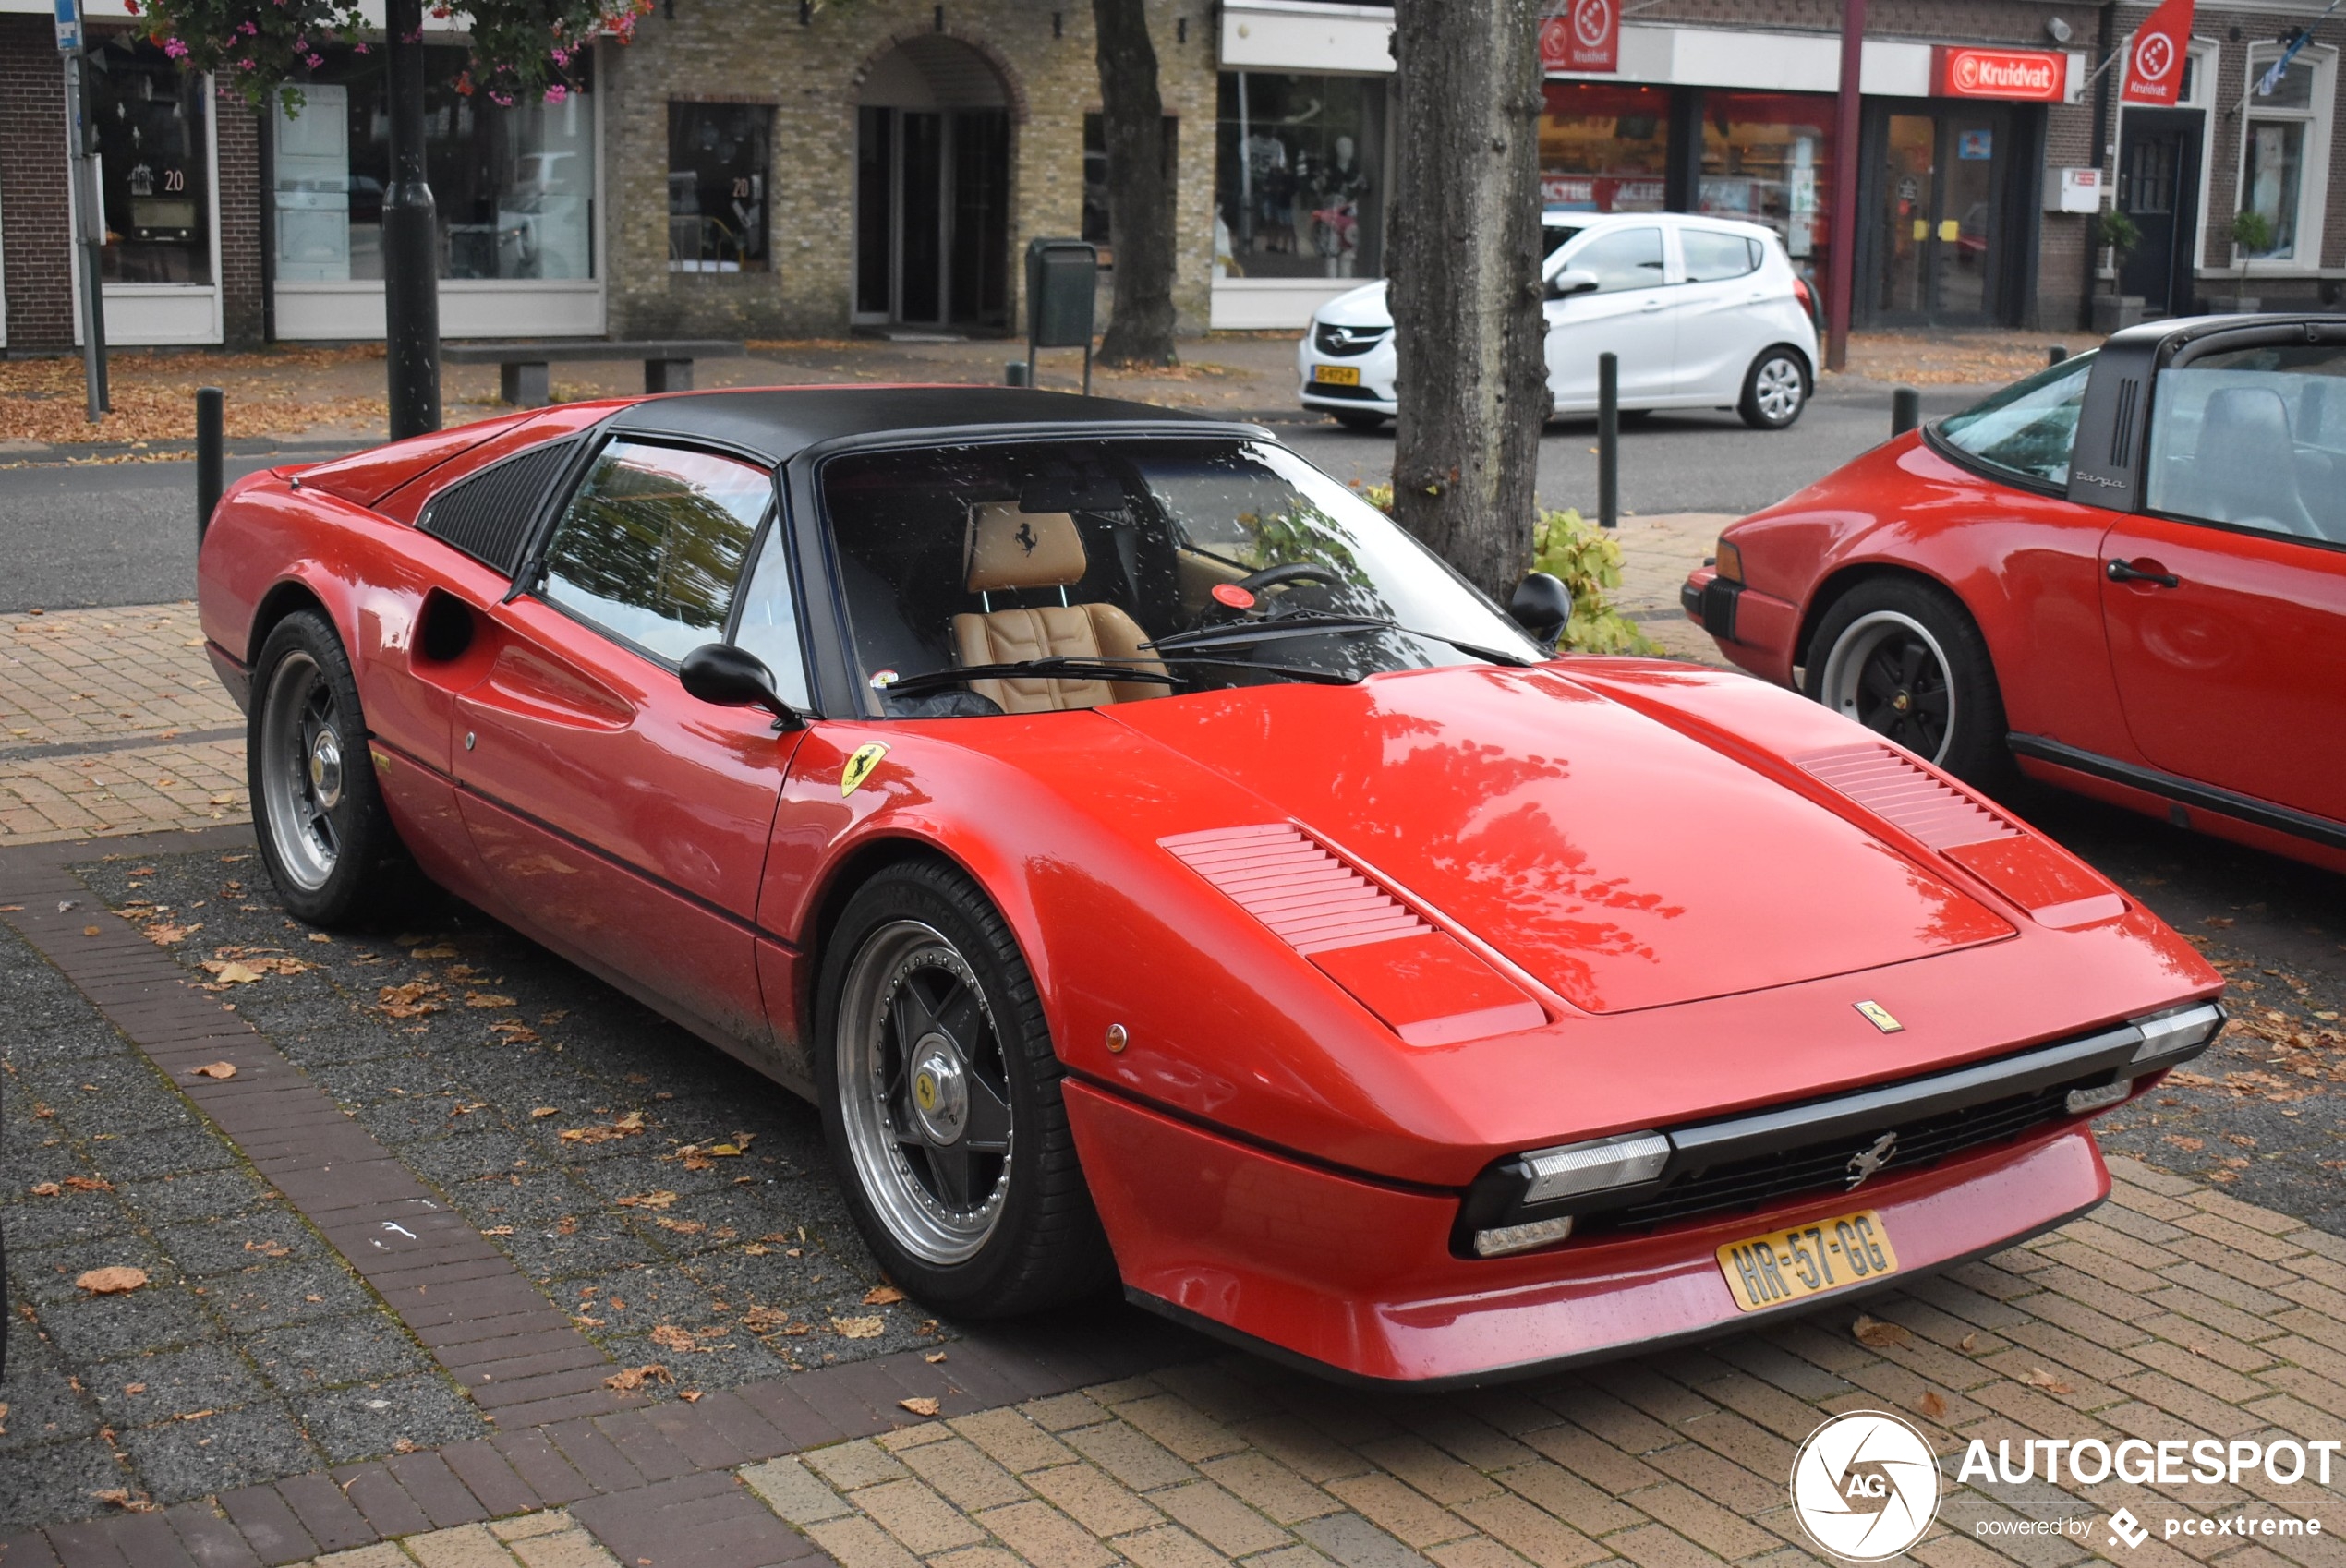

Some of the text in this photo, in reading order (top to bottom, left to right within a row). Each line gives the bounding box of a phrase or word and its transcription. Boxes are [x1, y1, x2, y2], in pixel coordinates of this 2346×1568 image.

[1979, 62, 2050, 89] Kruidvat
[2131, 80, 2167, 97] Kruidvat
[164, 170, 184, 191] 20
[732, 177, 749, 198] 20
[1731, 1215, 1888, 1304] HR-57-GG
